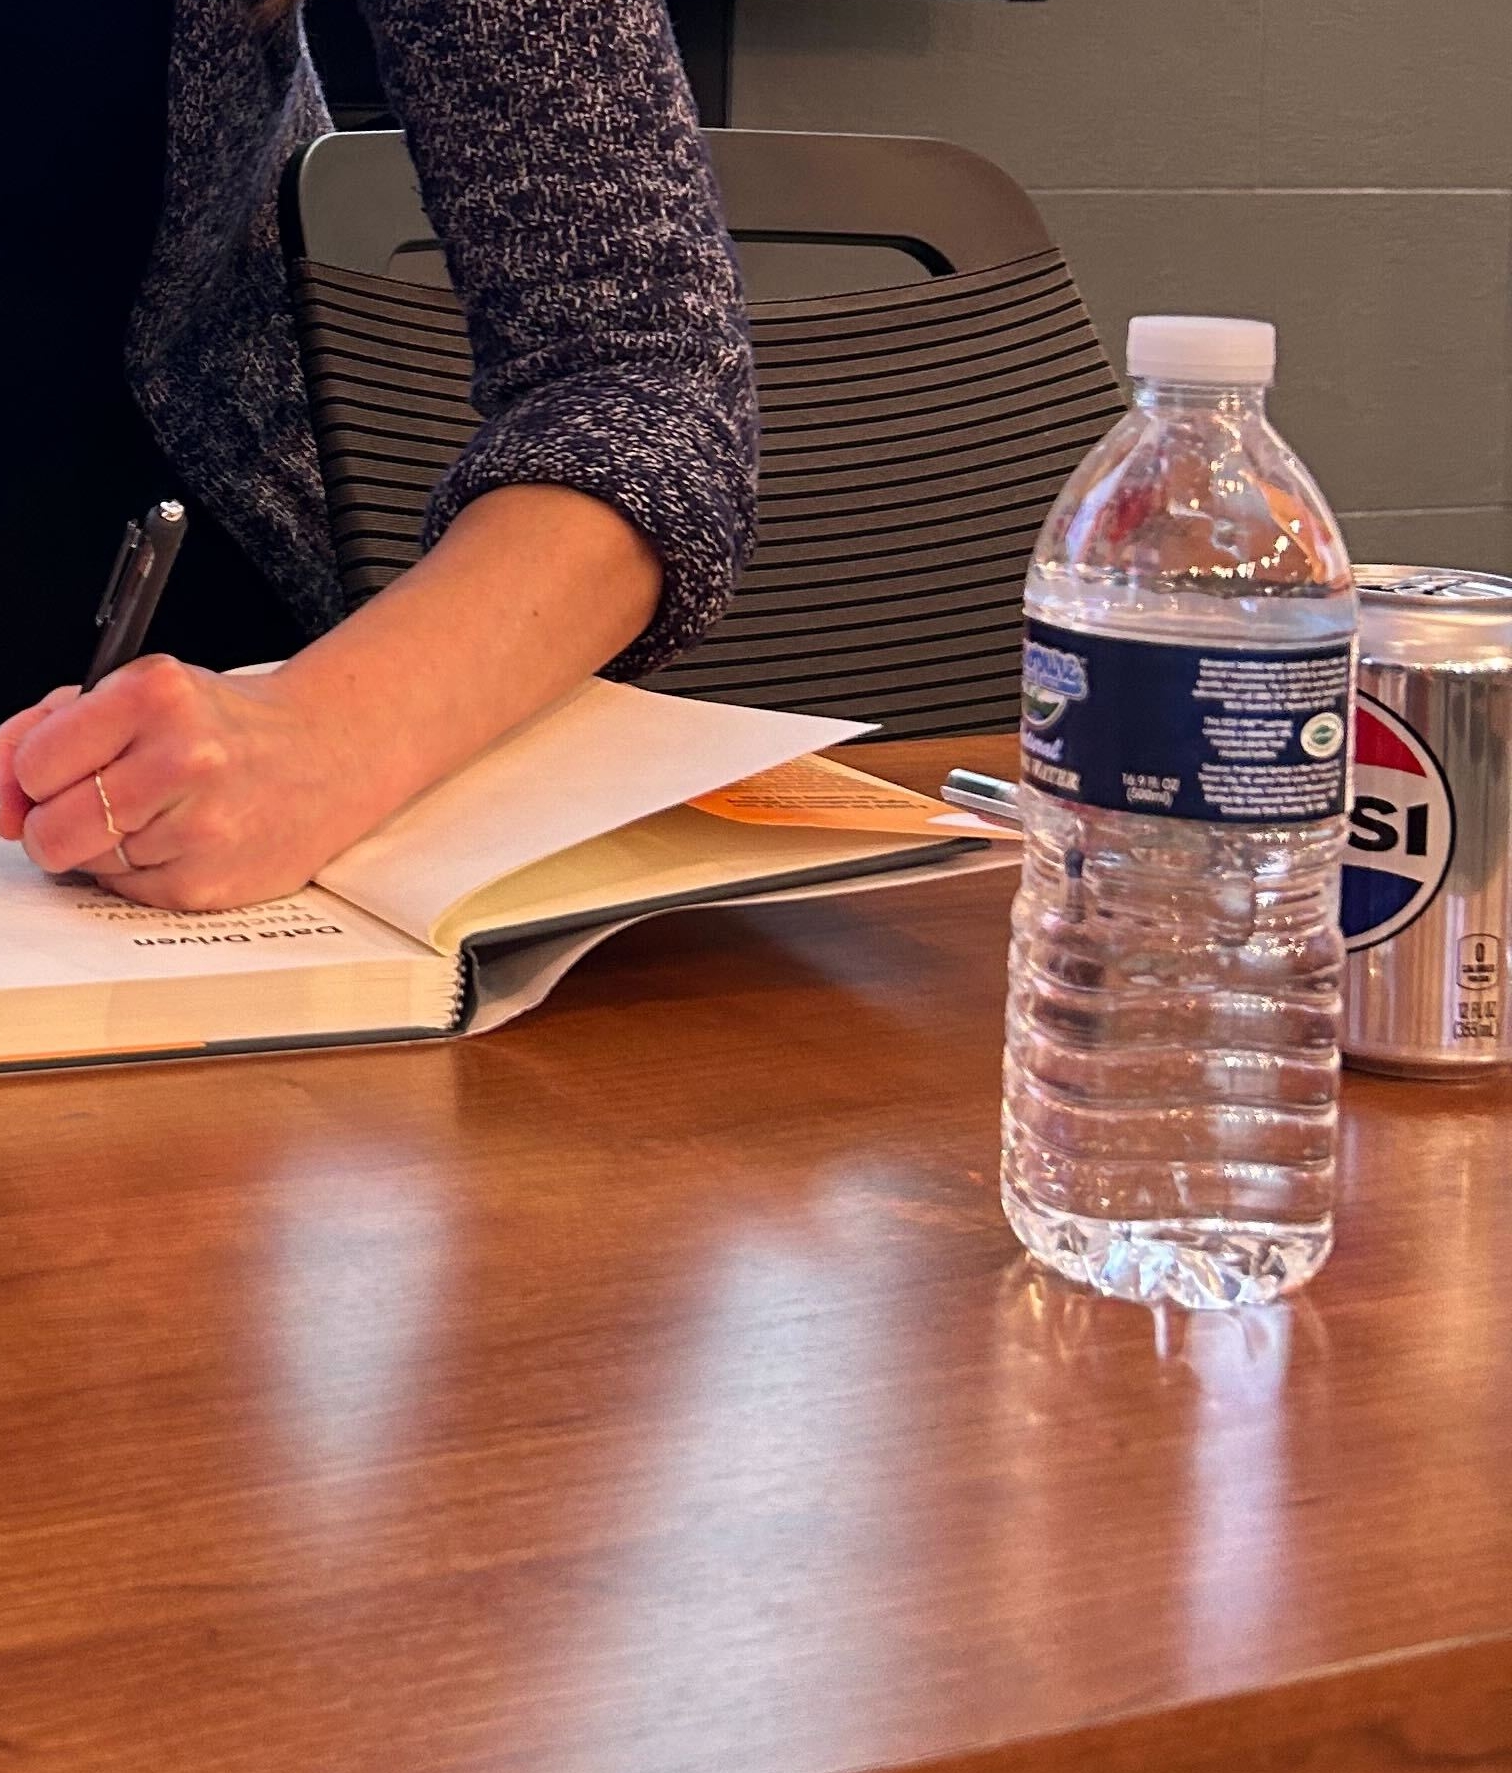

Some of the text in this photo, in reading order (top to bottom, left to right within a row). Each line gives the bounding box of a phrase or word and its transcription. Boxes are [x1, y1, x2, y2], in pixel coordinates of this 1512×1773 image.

[1347, 795, 1429, 856] SI
[163, 913, 327, 931] Truckers,
[132, 925, 344, 949] Data Driven
